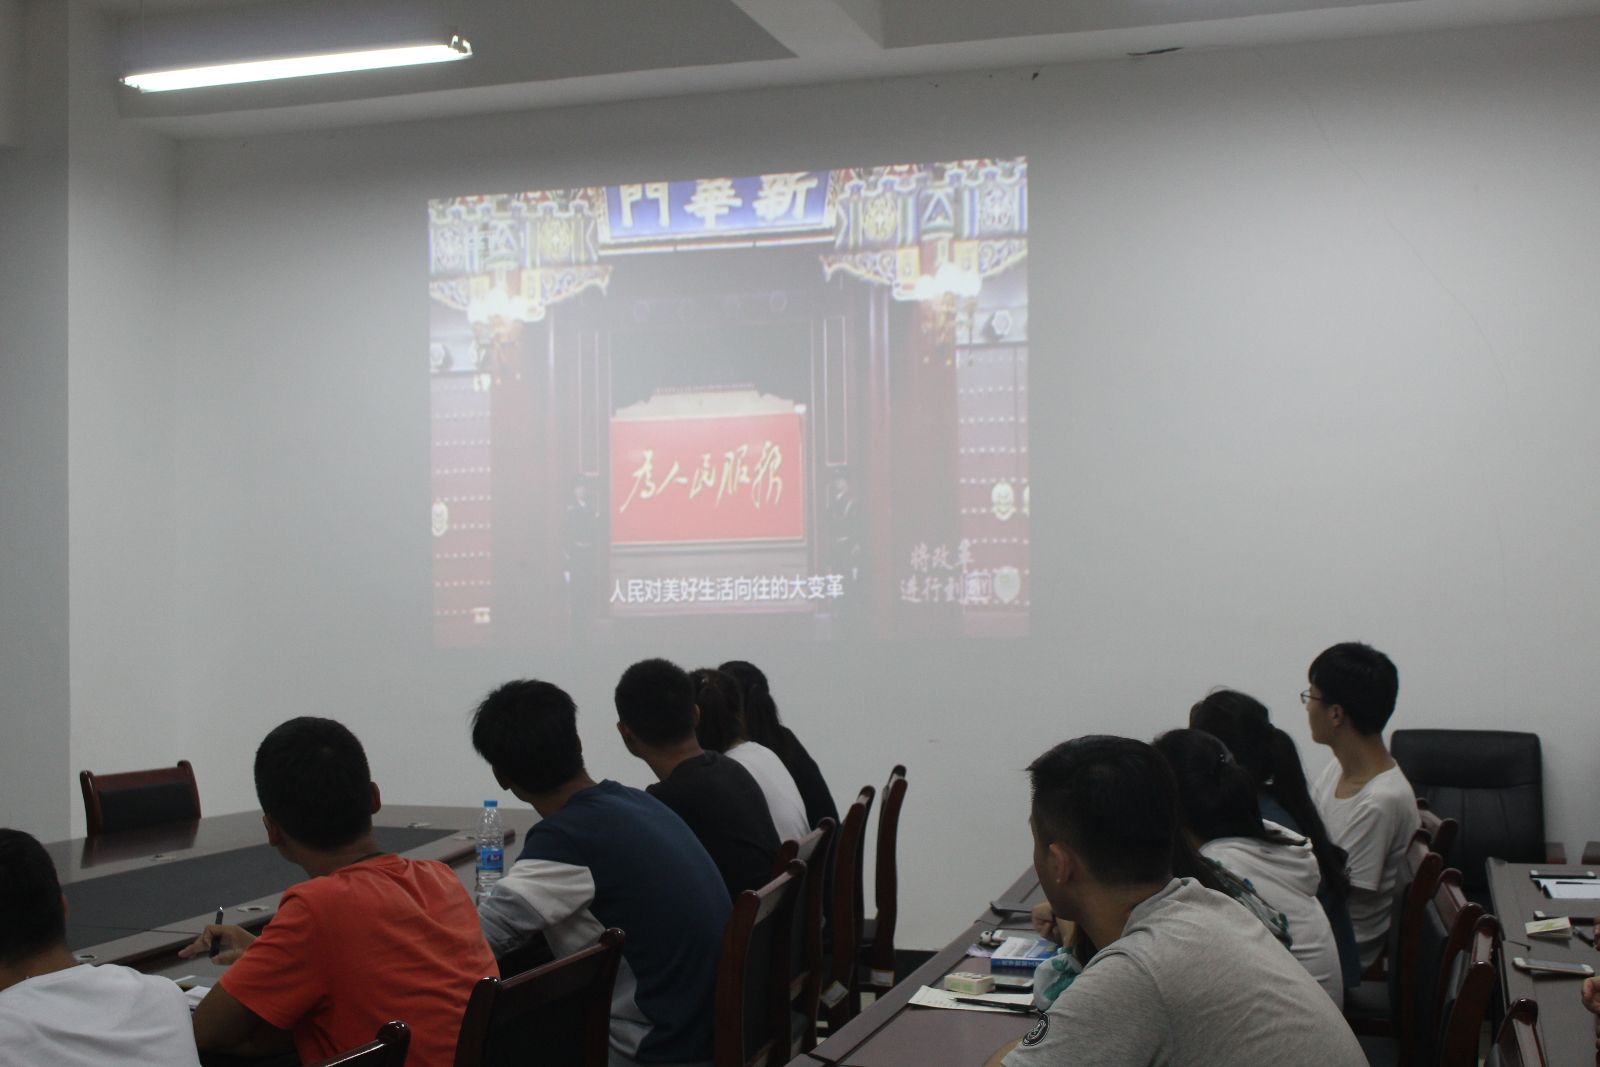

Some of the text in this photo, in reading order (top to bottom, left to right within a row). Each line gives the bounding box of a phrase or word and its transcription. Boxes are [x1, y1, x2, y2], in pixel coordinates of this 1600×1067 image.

[609, 574, 845, 603] 人民对美好生活向往的大变革
